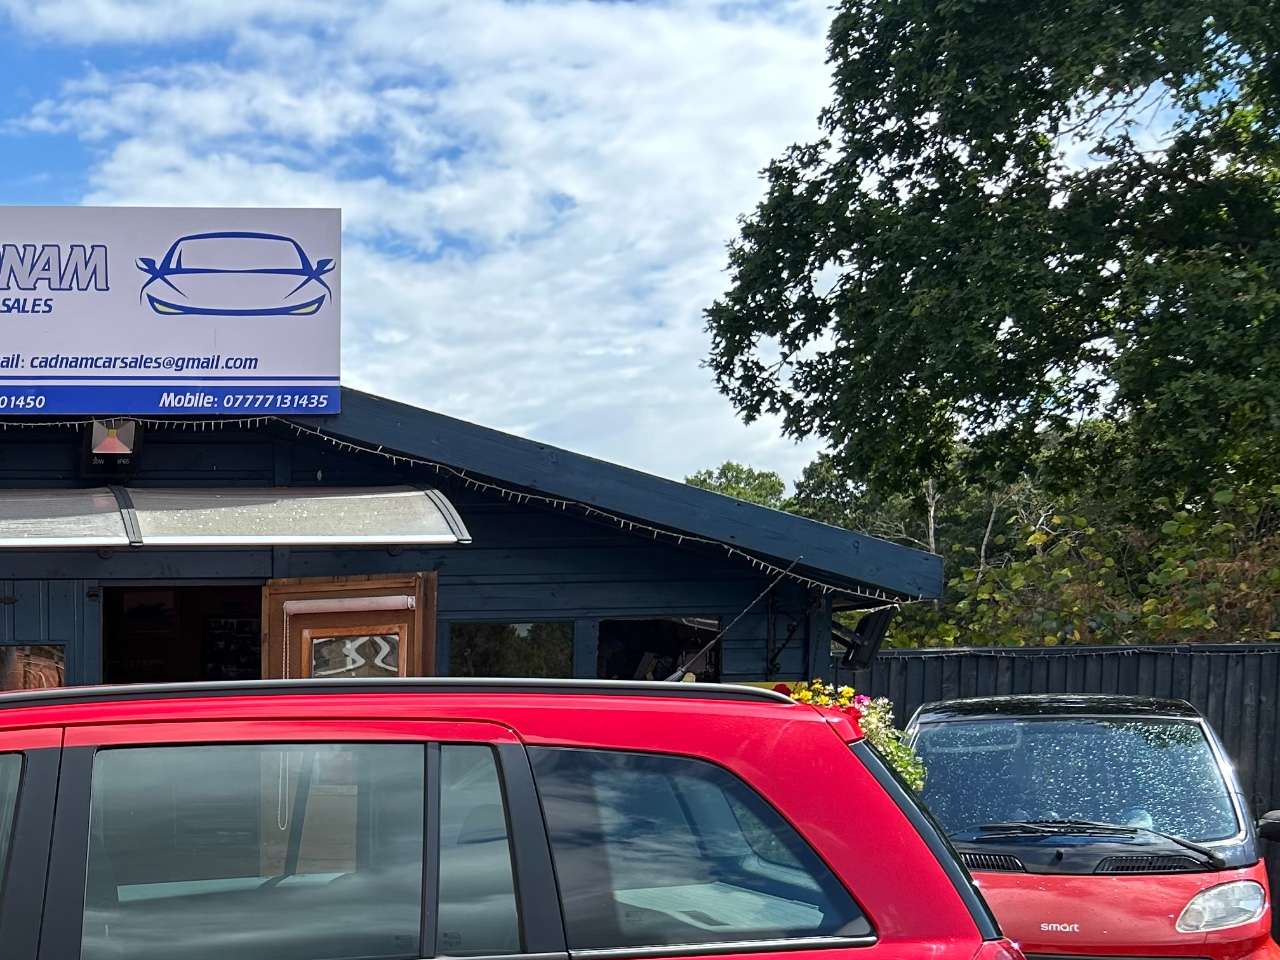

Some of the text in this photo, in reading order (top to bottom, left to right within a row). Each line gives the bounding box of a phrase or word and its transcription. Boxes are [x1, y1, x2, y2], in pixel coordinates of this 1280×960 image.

[0, 298, 53, 313] SALES
[30, 354, 258, 371] cadnamcarsales@gmail.com
[159, 393, 328, 408] Mobile: 07777131435
[1040, 922, 1080, 932] smart
